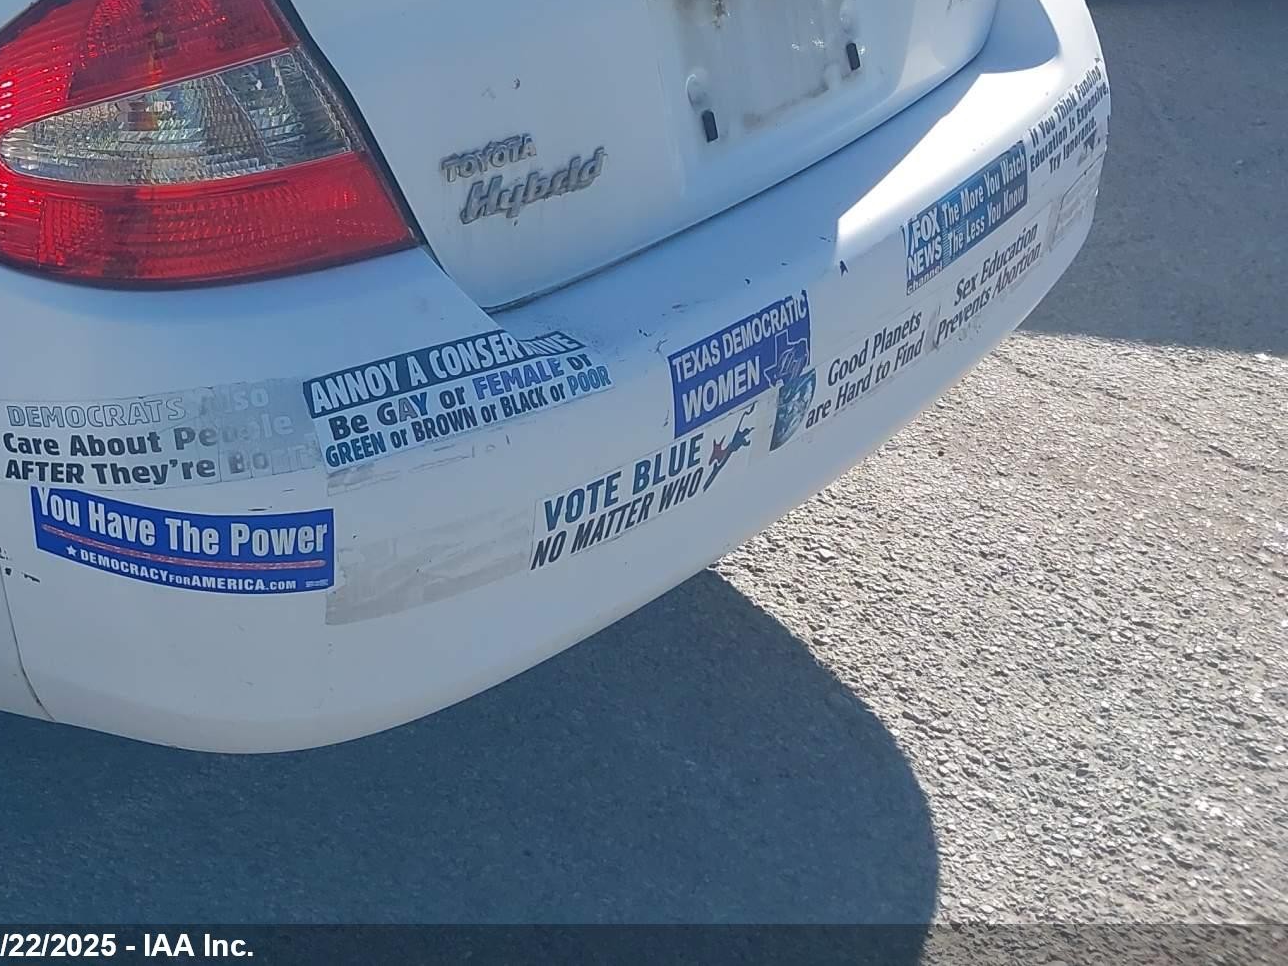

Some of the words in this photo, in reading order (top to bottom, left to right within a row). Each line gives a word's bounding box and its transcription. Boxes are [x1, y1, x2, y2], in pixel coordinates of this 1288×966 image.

[1029, 127, 1039, 148] If
[1038, 116, 1056, 138] You
[1053, 92, 1077, 123] Think
[1074, 65, 1102, 101] Funding
[1030, 125, 1067, 172] Education
[1068, 115, 1076, 134] Is
[441, 134, 537, 182] TOYOTA
[460, 146, 608, 225] Hybrid
[942, 201, 959, 228] The
[960, 185, 984, 215] More
[983, 170, 1000, 198] You
[1000, 148, 1025, 184] Watch
[1049, 152, 1061, 174] Try
[912, 207, 941, 249] FOX
[947, 230, 963, 256] The
[966, 215, 985, 243] Less
[986, 202, 1001, 227] You
[1003, 184, 1025, 215] Know
[907, 236, 943, 279] NEWS
[936, 287, 991, 345] Prevents
[992, 242, 1041, 298] Abortion
[954, 275, 978, 306] Sex
[981, 223, 1038, 285] Education
[672, 339, 721, 383] TEXAS
[722, 296, 807, 359] DEMOCRATIC
[827, 339, 869, 387] Good
[871, 311, 922, 359] Planets
[7, 397, 186, 428] DEMOCRATS
[312, 361, 400, 415] ANNOY
[407, 356, 426, 386] A
[325, 433, 387, 468] GREEN
[390, 427, 409, 449] or
[411, 407, 478, 442] BROWN
[480, 402, 499, 424] or
[500, 386, 549, 418] BLACK
[550, 384, 566, 403] or
[568, 366, 612, 396] POOR
[328, 413, 369, 441] Be
[376, 392, 428, 426] GAY
[439, 387, 467, 411] or
[472, 358, 562, 400] FEMALE
[567, 353, 592, 371] or
[682, 356, 760, 423] WOMEN
[806, 399, 831, 429] are
[835, 364, 872, 410] Hard
[875, 360, 890, 384] to
[893, 331, 925, 372] Find
[3, 433, 60, 456] Care
[70, 431, 162, 456] About
[5, 459, 85, 484] AFTER
[91, 458, 216, 485] They're
[531, 531, 567, 571] NO
[571, 492, 654, 554] MATTER
[658, 467, 704, 513] WHO
[544, 471, 622, 532] VOTE
[632, 433, 704, 495] BLUE
[38, 487, 80, 528] You
[88, 499, 156, 546] Have
[165, 518, 220, 555] The
[230, 522, 328, 557] Power
